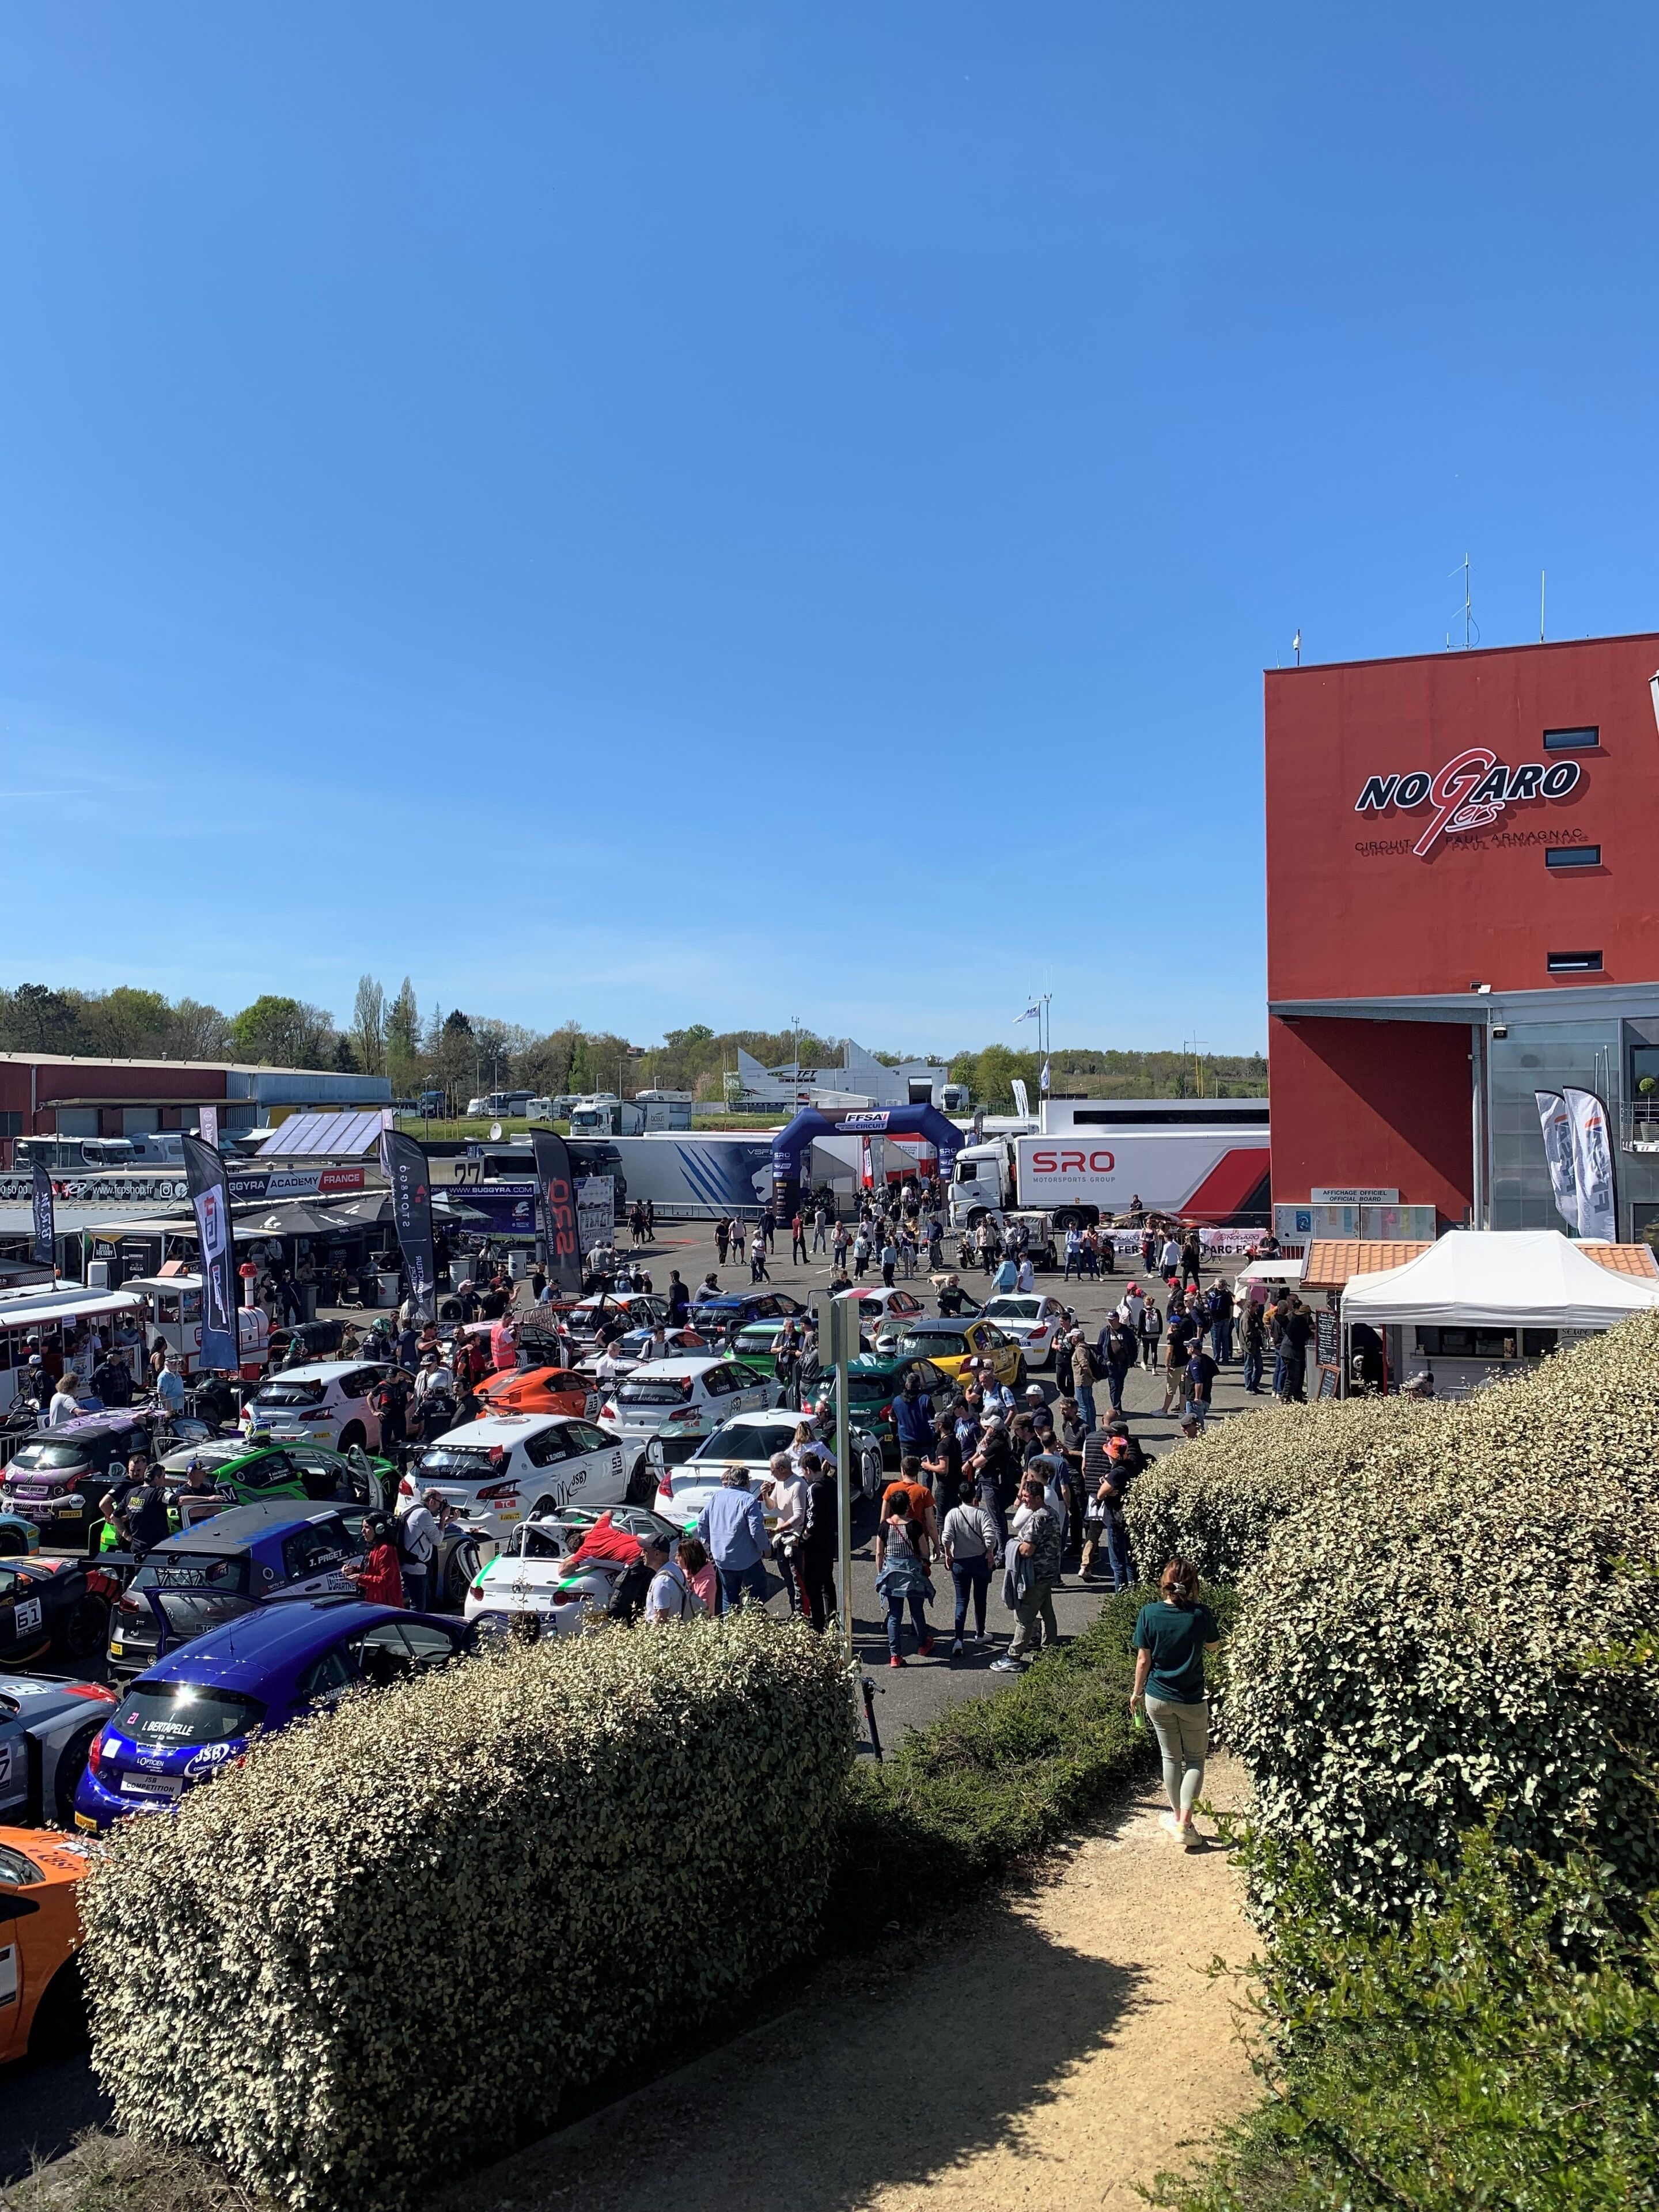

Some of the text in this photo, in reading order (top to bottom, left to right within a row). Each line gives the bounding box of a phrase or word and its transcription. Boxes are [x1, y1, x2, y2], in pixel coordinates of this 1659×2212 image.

[1355, 748, 1580, 855] NOGARO
[1355, 829, 1583, 851] CIRCUIT PAUL ARMAGNAC
[847, 1113, 883, 1122] FFSA
[1032, 1151, 1115, 1173] SRO
[229, 1173, 360, 1191] GGYRA ACADEMY FRANCE
[7, 1185, 17, 1194] 50
[18, 1185, 28, 1194] 00
[92, 1184, 154, 1196] www.fcpshop.fr
[1204, 1245, 1233, 1254] PARC
[588, 1400, 598, 1411] 33
[612, 1456, 622, 1469] 53
[317, 1550, 343, 1563] PAGET
[17, 1607, 40, 1629] 61
[127, 1712, 140, 1725] 21
[146, 1721, 195, 1736] BERTAPELLE
[194, 1744, 222, 1763] JSB
[193, 1763, 226, 1772] COMPETIION
[126, 1782, 175, 1793] COMPETITION
